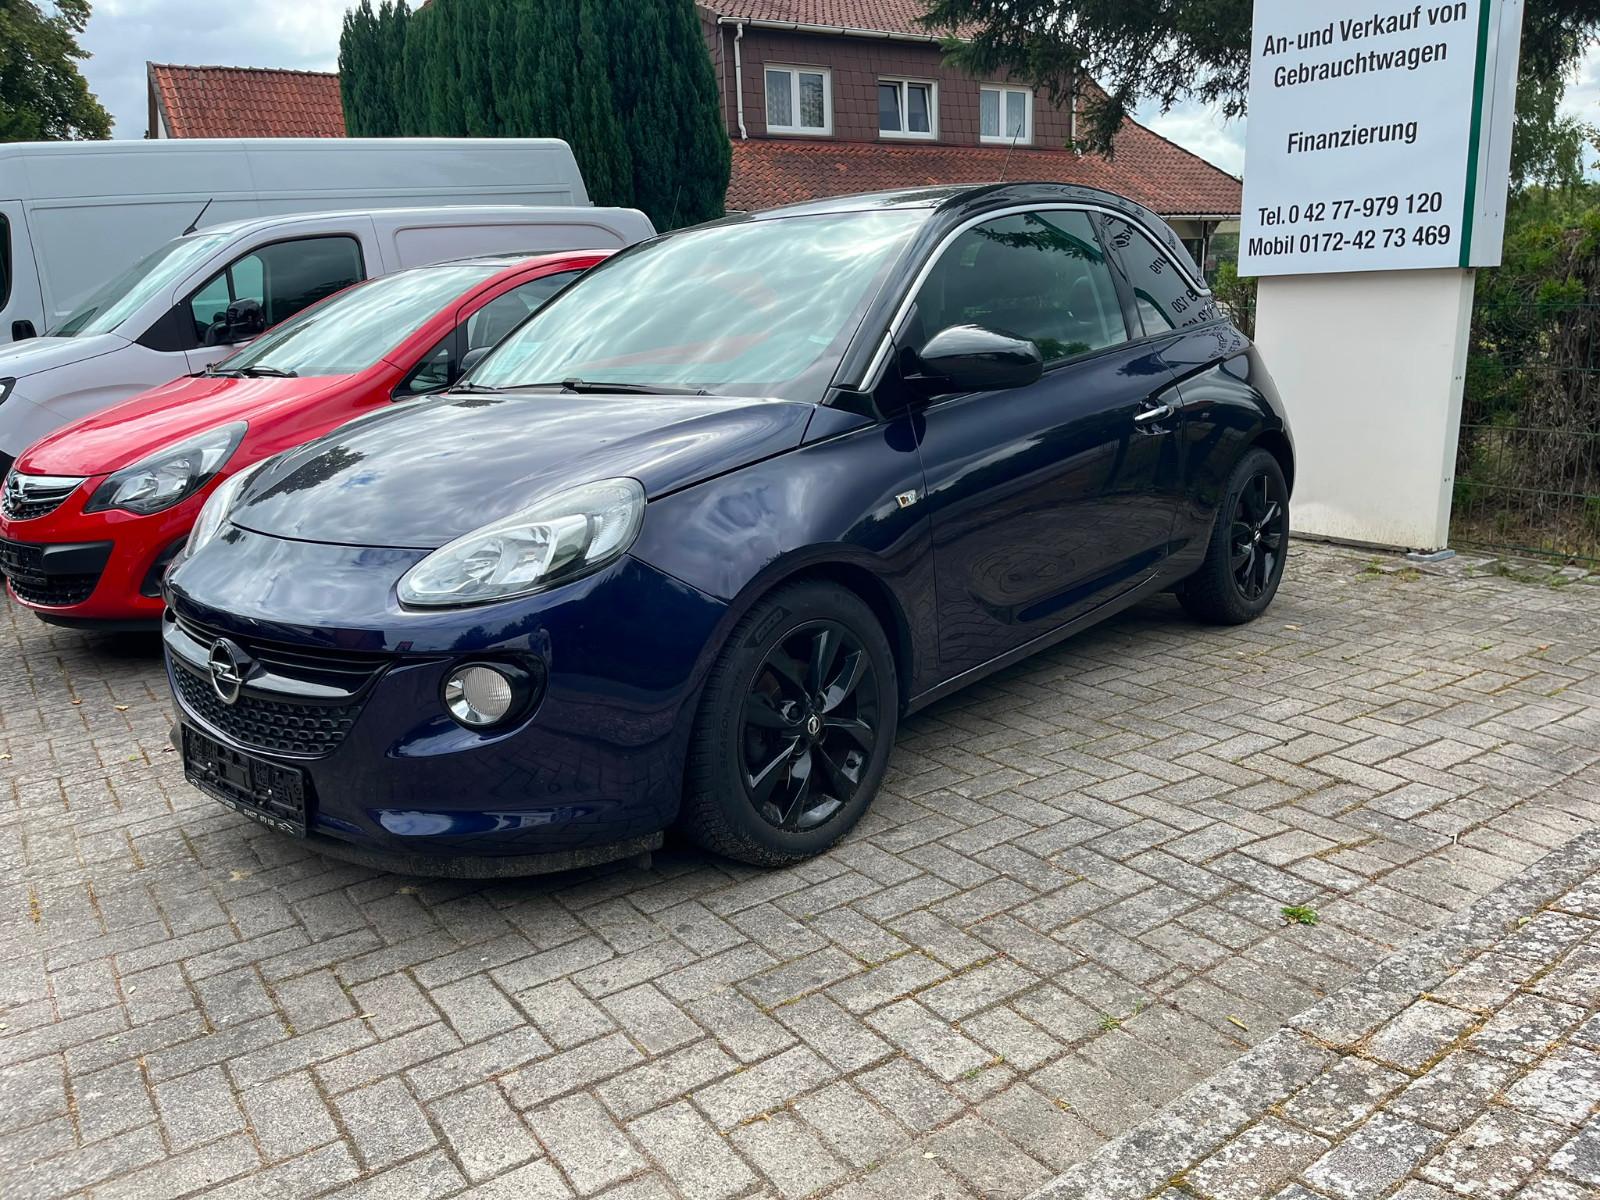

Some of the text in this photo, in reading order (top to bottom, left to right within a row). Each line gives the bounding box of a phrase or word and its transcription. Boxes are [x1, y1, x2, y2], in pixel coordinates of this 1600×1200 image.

[1339, 4, 1422, 42] Verkauf
[1427, 1, 1467, 26] von
[1274, 42, 1447, 88] Gebrauchtwagen
[1287, 121, 1418, 154] Finanzierung
[1331, 195, 1399, 221] 77-979
[1405, 191, 1443, 214] 120
[1248, 224, 1451, 257] Mobil 0172-42 73 469
